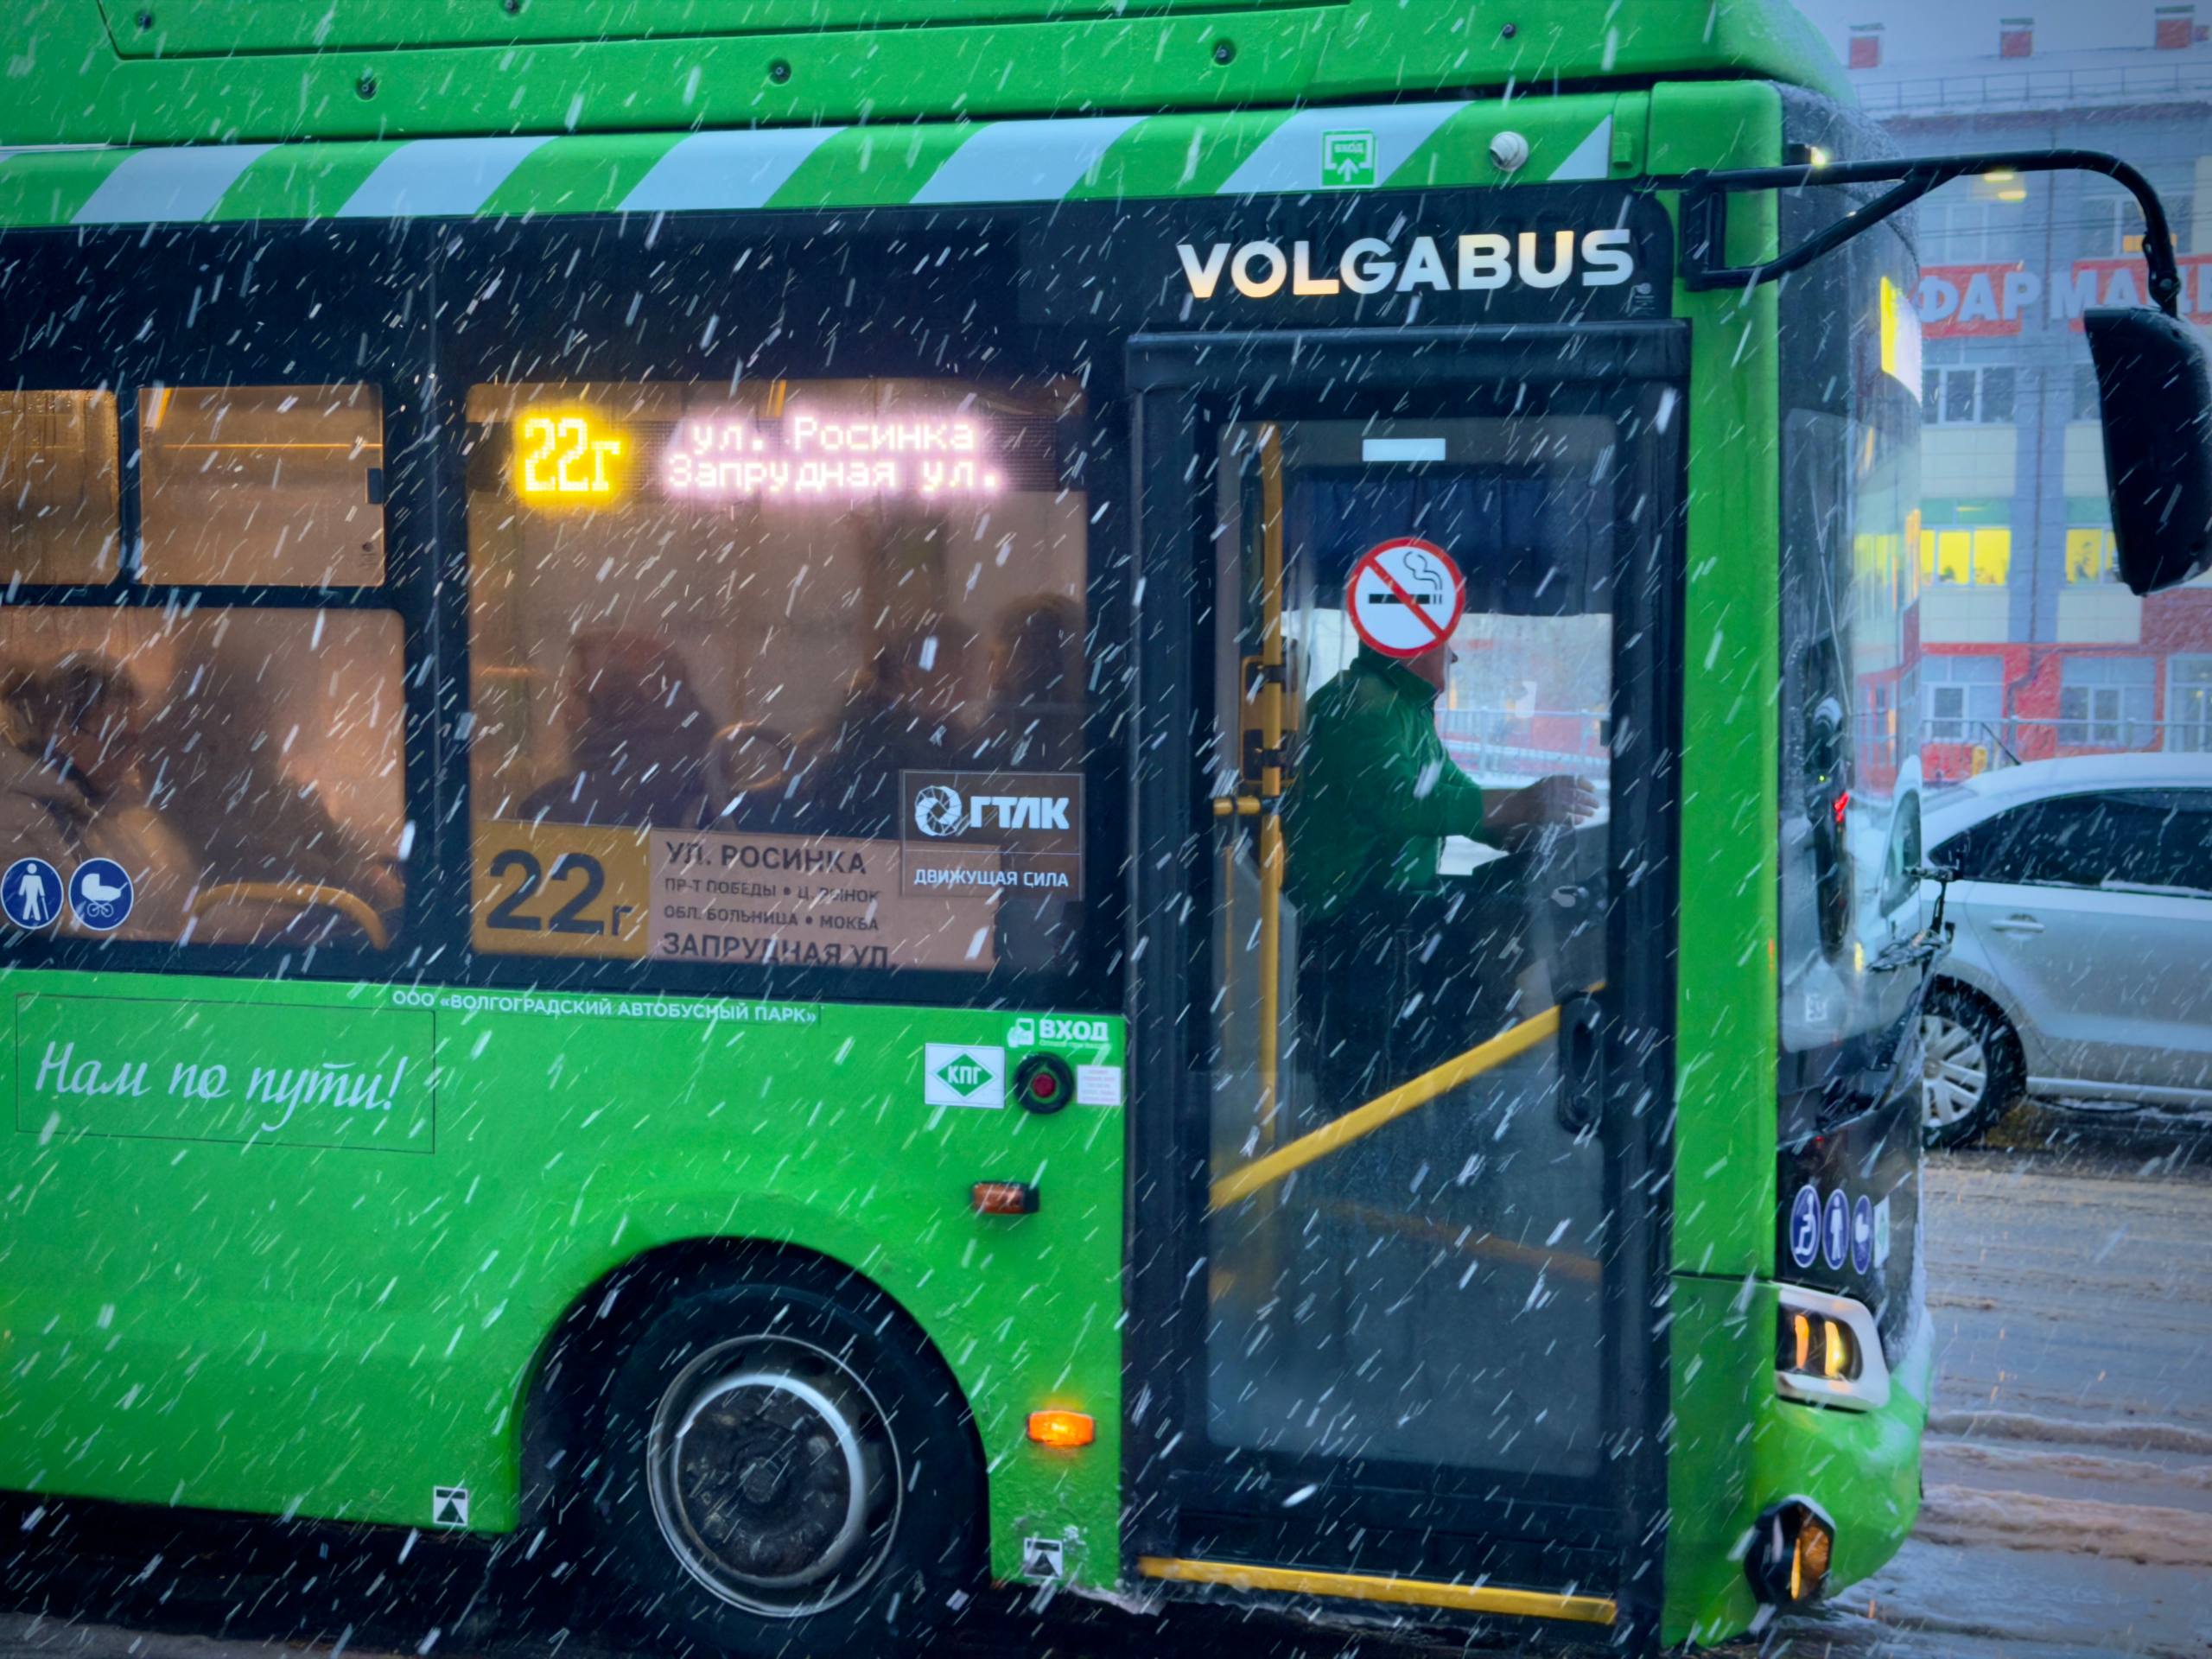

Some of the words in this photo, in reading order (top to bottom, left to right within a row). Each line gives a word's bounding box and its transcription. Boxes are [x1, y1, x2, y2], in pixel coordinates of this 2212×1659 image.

[1177, 228, 1635, 299] VOLGABUS
[692, 423, 765, 456] ул.
[791, 416, 974, 452] Росинка
[668, 453, 896, 493] Запрудная
[921, 461, 997, 493] ул.
[969, 795, 1071, 830] ГТЛК
[665, 841, 711, 865] УЛ.
[721, 844, 868, 874] РОСИНКА
[664, 878, 702, 893] ПР-Т
[707, 880, 777, 898] ПОБЕДЫ
[819, 887, 880, 904] РЫНОК
[913, 868, 1018, 887] ДВИЖУЩАЯ
[1022, 871, 1070, 888] СИЛА
[664, 905, 702, 919] ОБЛ.
[707, 906, 798, 926] БОЛЬНИЦА
[662, 931, 842, 965] ЗАПРУДНАЯ
[392, 990, 435, 1007] ООО
[439, 994, 613, 1017] «ВОЛГОГРАДСКИЙ
[618, 1001, 749, 1021] АВТОБУСНЫЙ
[754, 1005, 817, 1024] ПАРК»
[1039, 1019, 1109, 1042] ВХОД
[35, 1040, 151, 1096] Нам
[168, 1061, 231, 1100] по
[245, 1055, 410, 1132] пути!
[947, 1065, 982, 1085] КПГ
